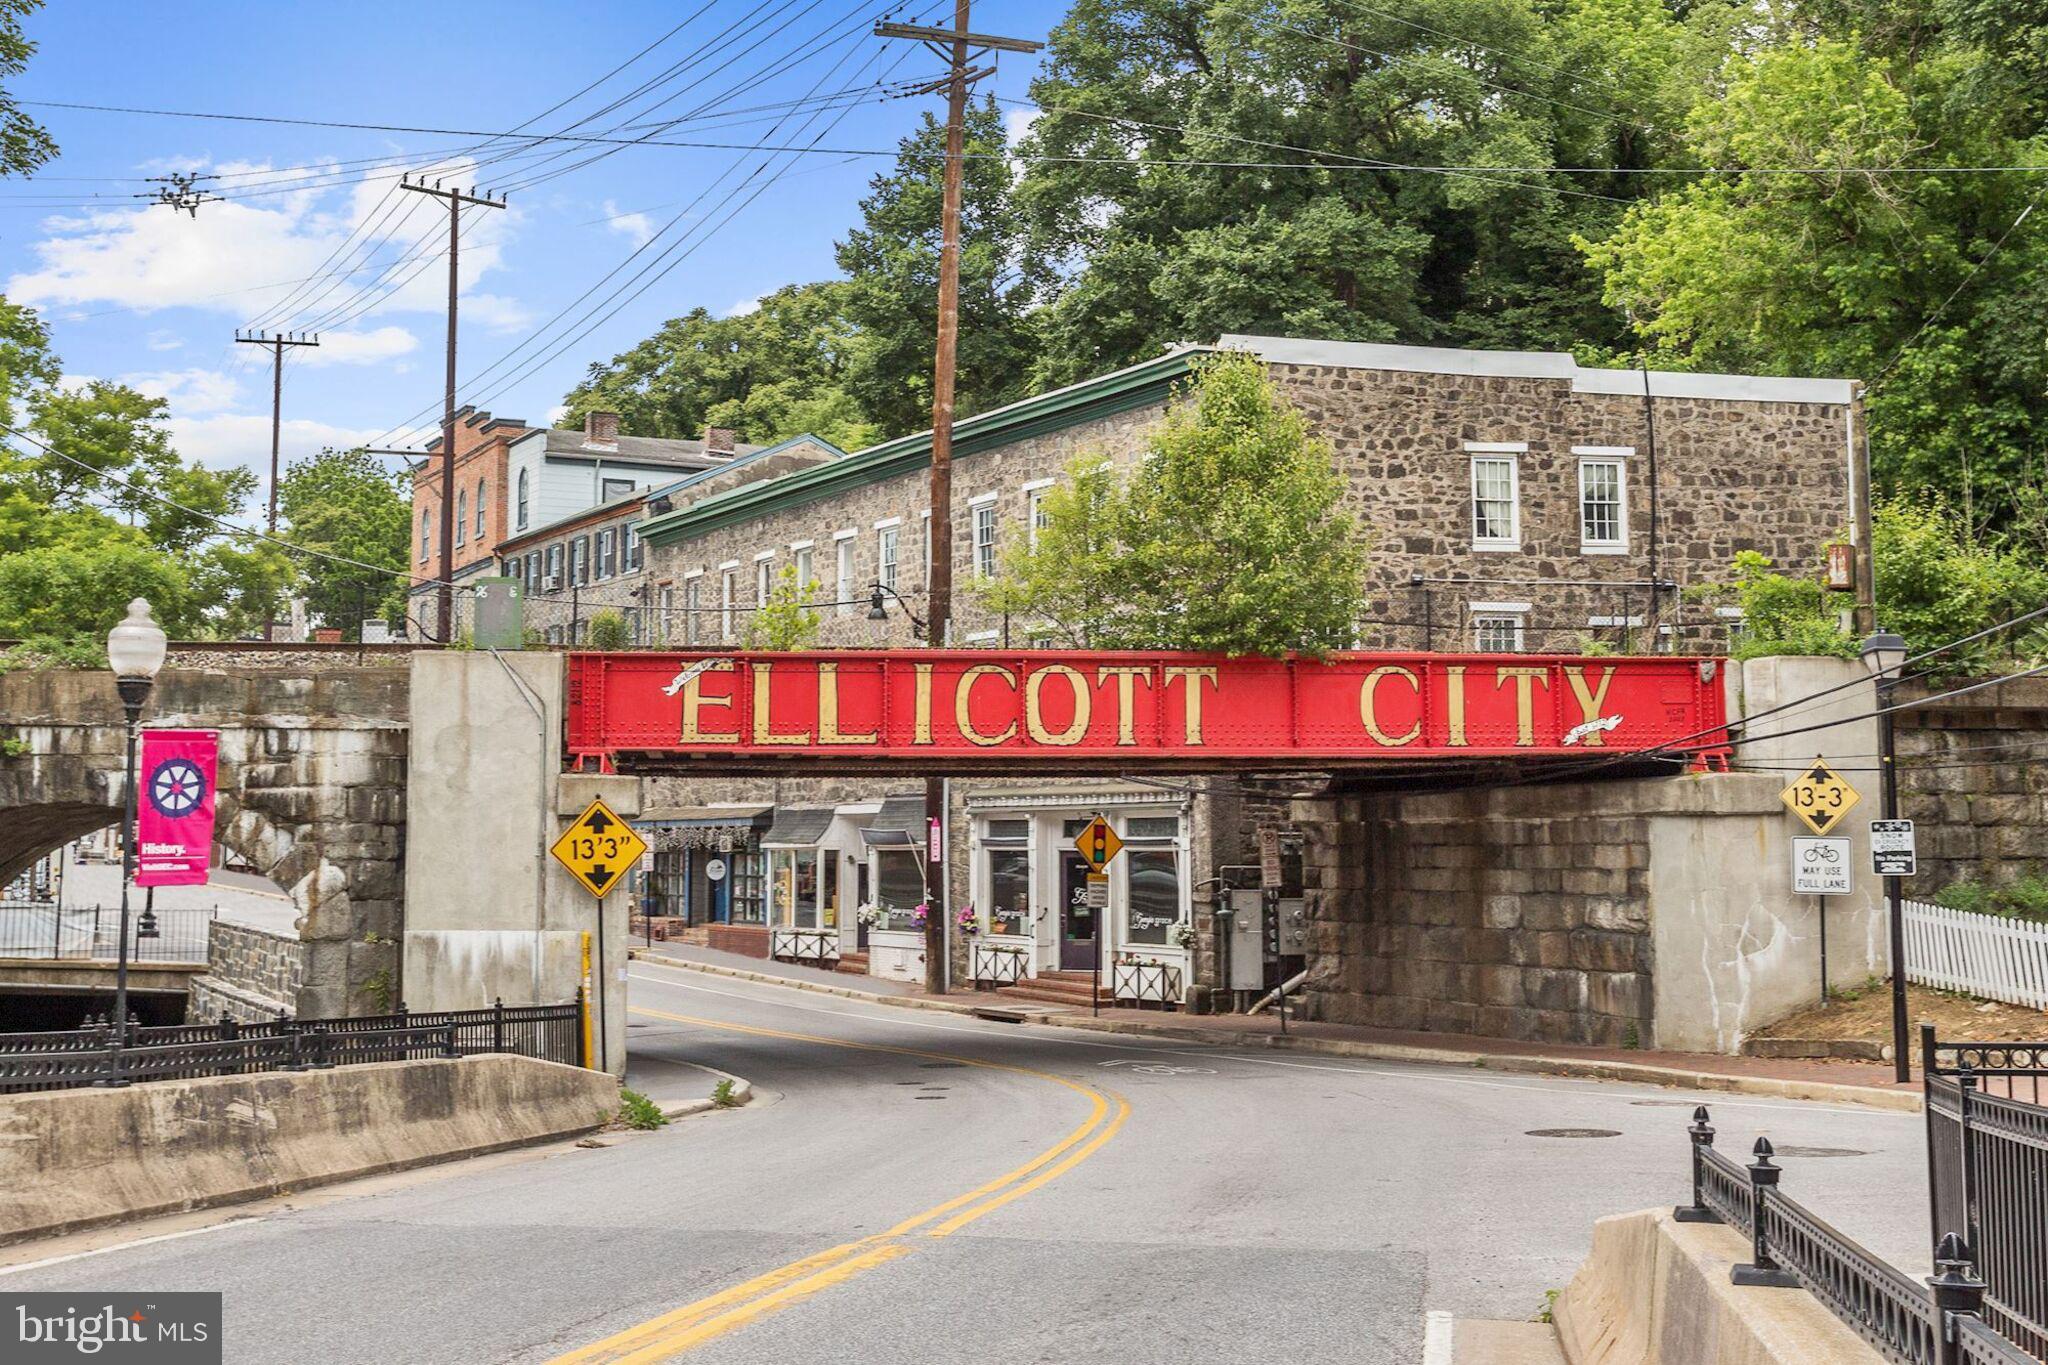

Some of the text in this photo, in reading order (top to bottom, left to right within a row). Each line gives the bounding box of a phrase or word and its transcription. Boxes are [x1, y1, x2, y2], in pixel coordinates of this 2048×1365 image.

[679, 660, 1617, 748] ELLICOTT CITY
[141, 842, 186, 857] History.
[1802, 866, 1842, 876] MAY USE
[1798, 878, 1847, 889] FULL LANE
